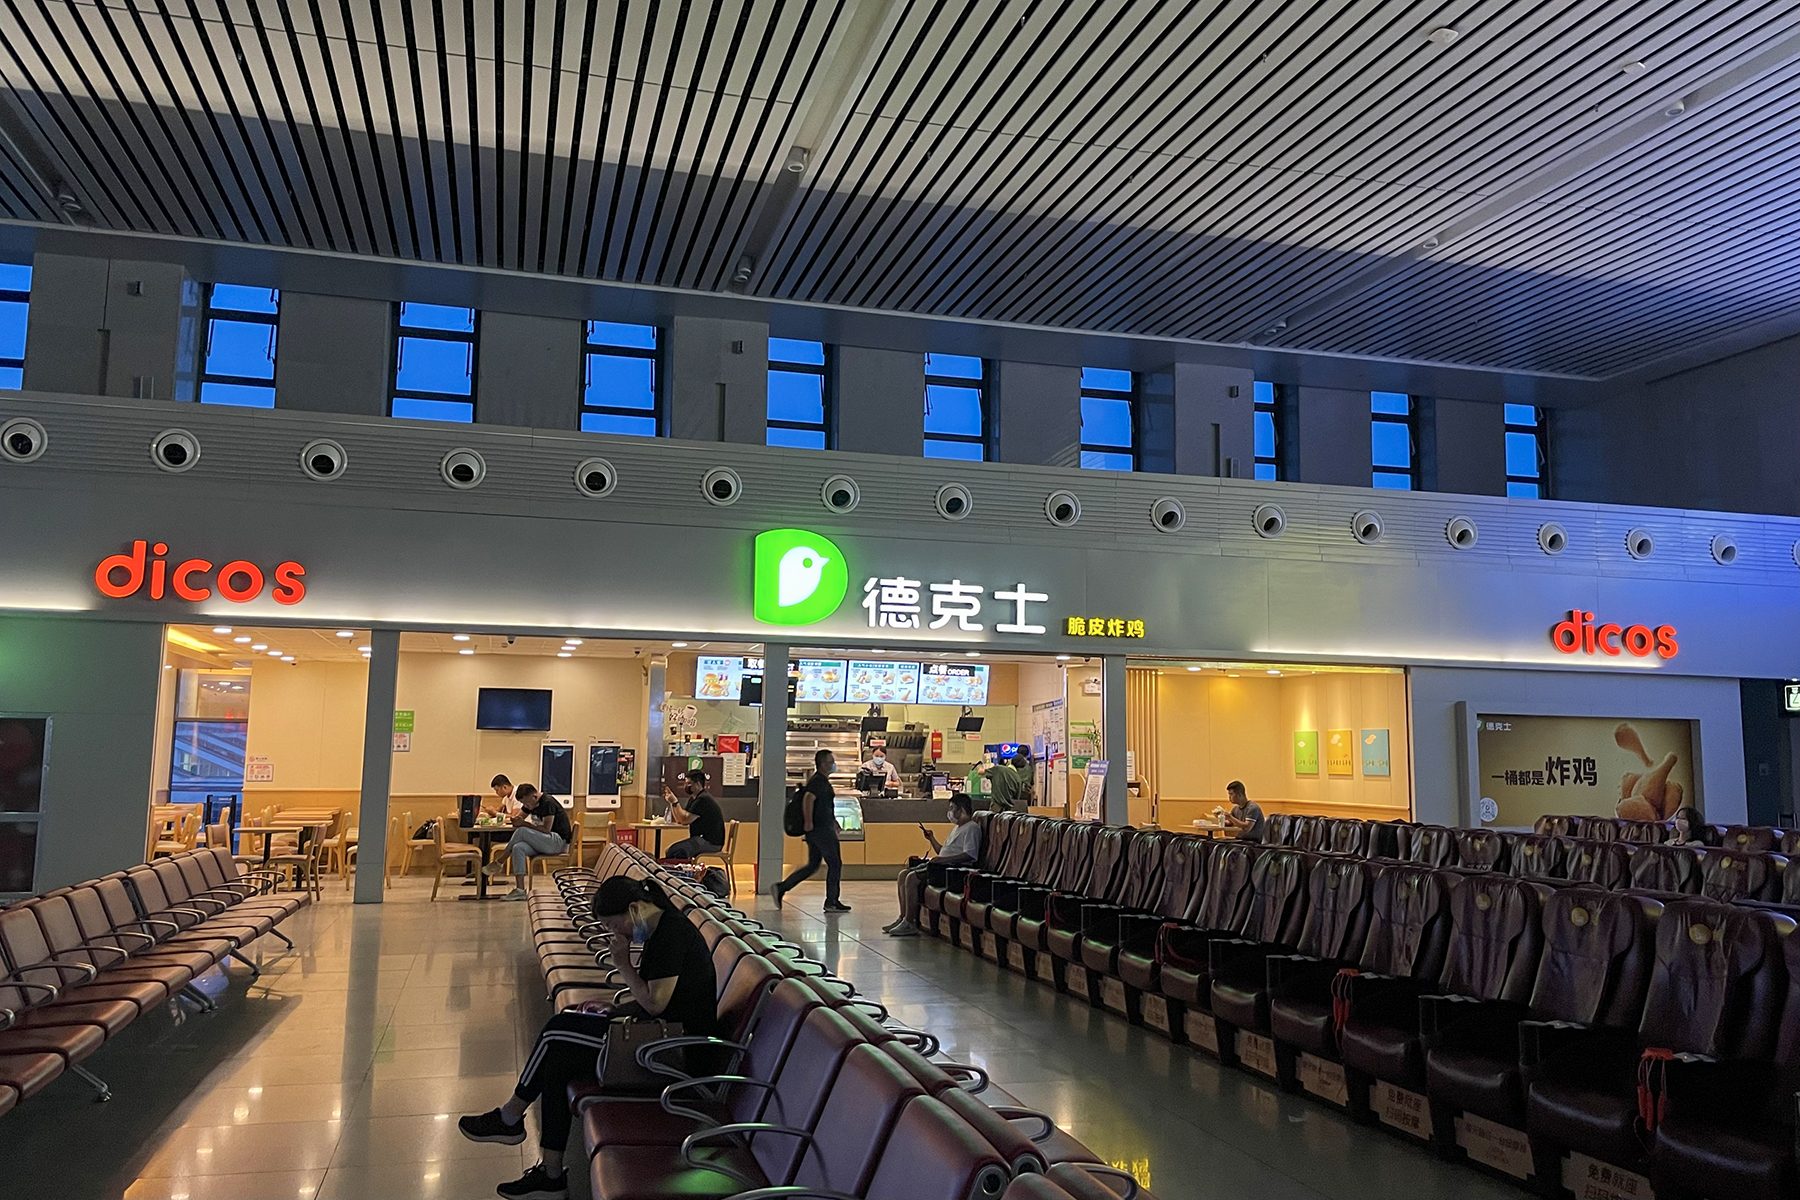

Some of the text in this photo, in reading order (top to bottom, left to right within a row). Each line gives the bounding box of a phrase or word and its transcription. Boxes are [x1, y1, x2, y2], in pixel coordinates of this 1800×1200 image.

[95, 539, 305, 605] dicos
[862, 576, 1049, 635] 德克士
[1066, 616, 1145, 638] 脆皮炸鸡
[1552, 609, 1679, 659] dicos
[1491, 756, 1598, 786] 一桶都是炸鸡
